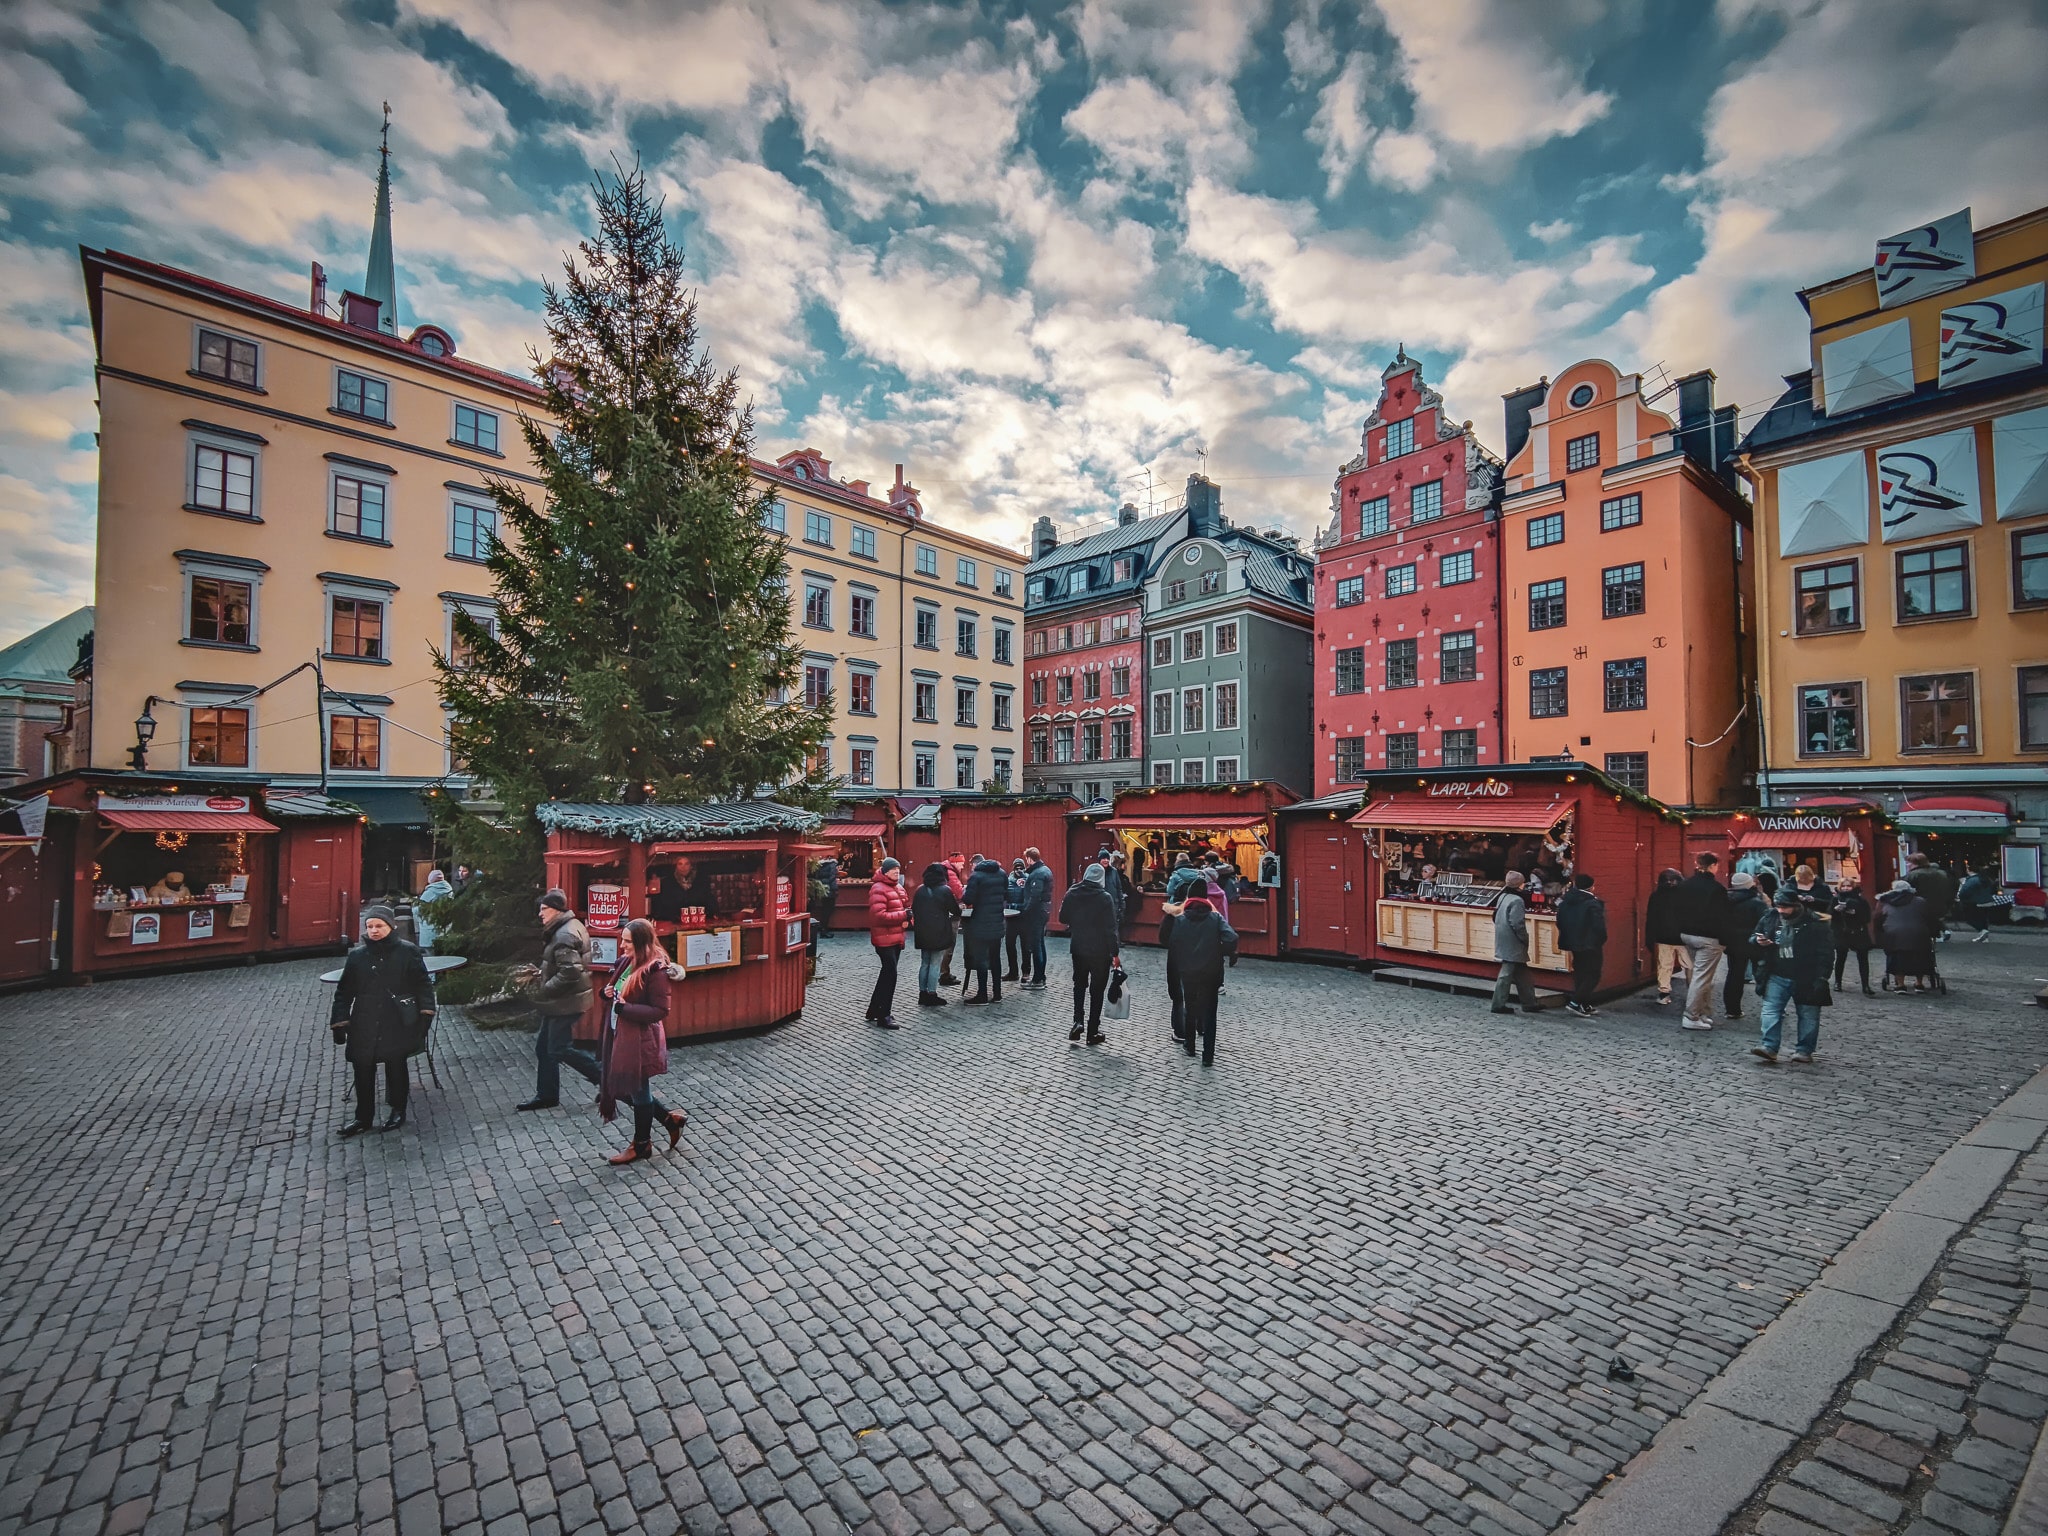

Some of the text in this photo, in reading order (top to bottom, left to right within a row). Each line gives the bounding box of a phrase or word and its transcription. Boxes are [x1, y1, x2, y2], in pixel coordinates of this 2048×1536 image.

[1431, 782, 1509, 796] LAPPLAND
[1758, 816, 1842, 830] VARMKORV
[592, 893, 617, 902] VARM
[590, 902, 618, 915] GLÖGG
